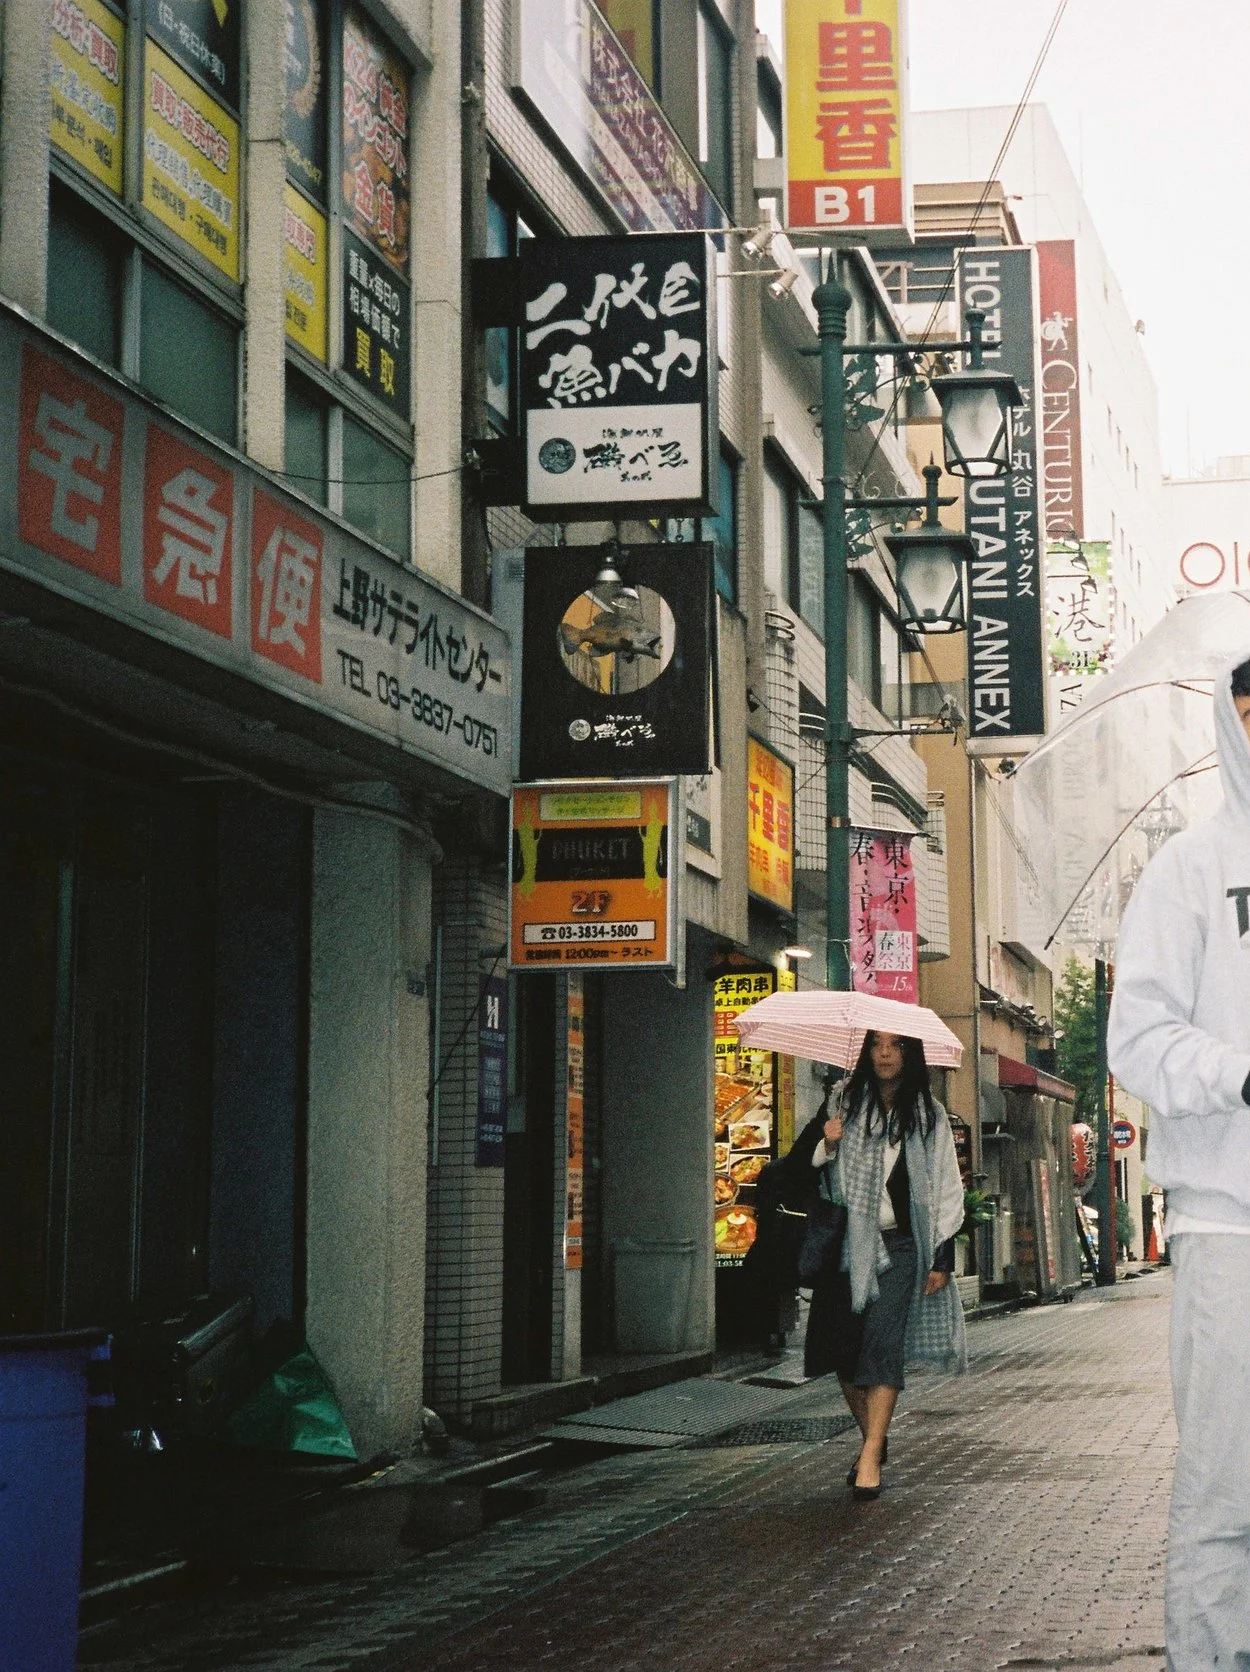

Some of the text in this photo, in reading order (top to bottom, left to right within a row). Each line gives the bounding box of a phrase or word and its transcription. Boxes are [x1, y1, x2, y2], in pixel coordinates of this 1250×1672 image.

[815, 0, 897, 172] 里香
[814, 185, 876, 223] B1
[526, 261, 700, 350] 二代目
[538, 329, 702, 409] 魚バカ
[1012, 449, 1034, 498] 丸谷
[26, 391, 317, 656] 宅急便
[1014, 511, 1036, 597] アネックス
[332, 556, 502, 694] 上野サテライトセンター
[337, 649, 498, 760] TEL 03-3837-0751
[972, 614, 1012, 732] ANNEX
[558, 925, 639, 939] 03-3834-5800
[571, 890, 612, 915] 2F
[714, 977, 769, 994] 羊肉串
